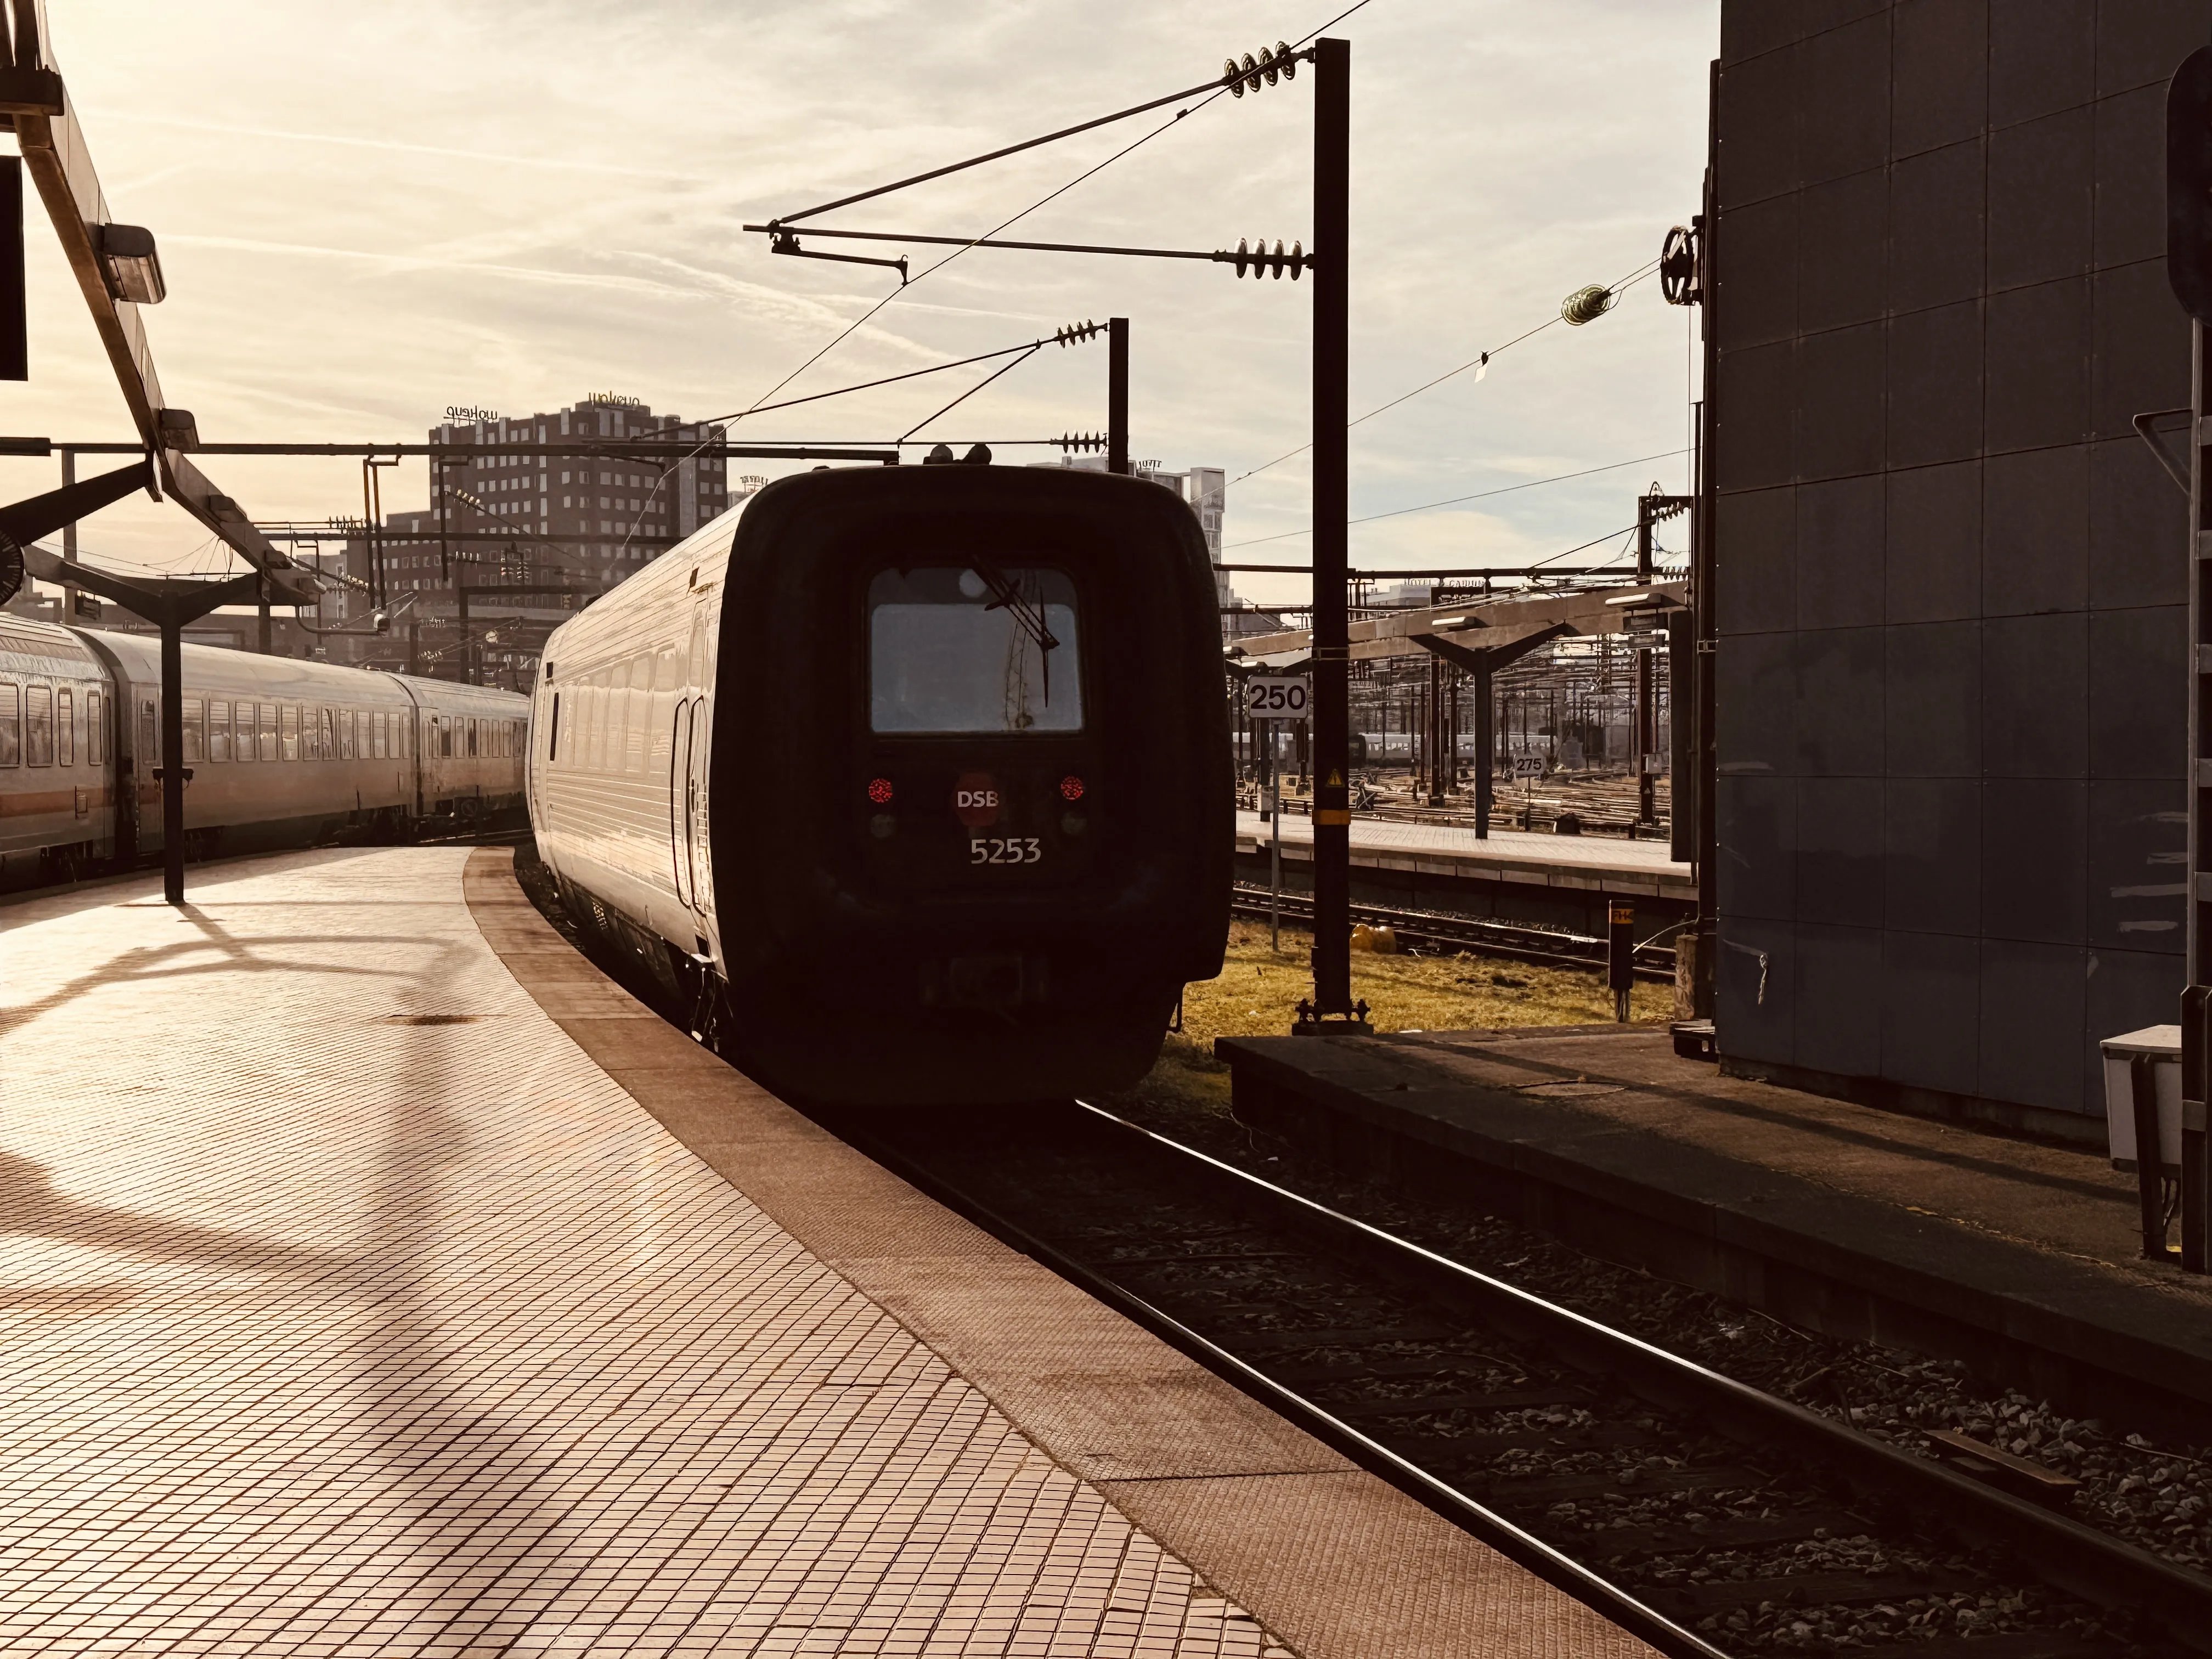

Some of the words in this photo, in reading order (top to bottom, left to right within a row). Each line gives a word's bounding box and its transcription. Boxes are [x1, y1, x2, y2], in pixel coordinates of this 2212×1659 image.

[1250, 684, 1306, 710] 250
[1516, 758, 1542, 771] 275
[957, 791, 999, 808] DSB
[970, 838, 1041, 864] 5253
